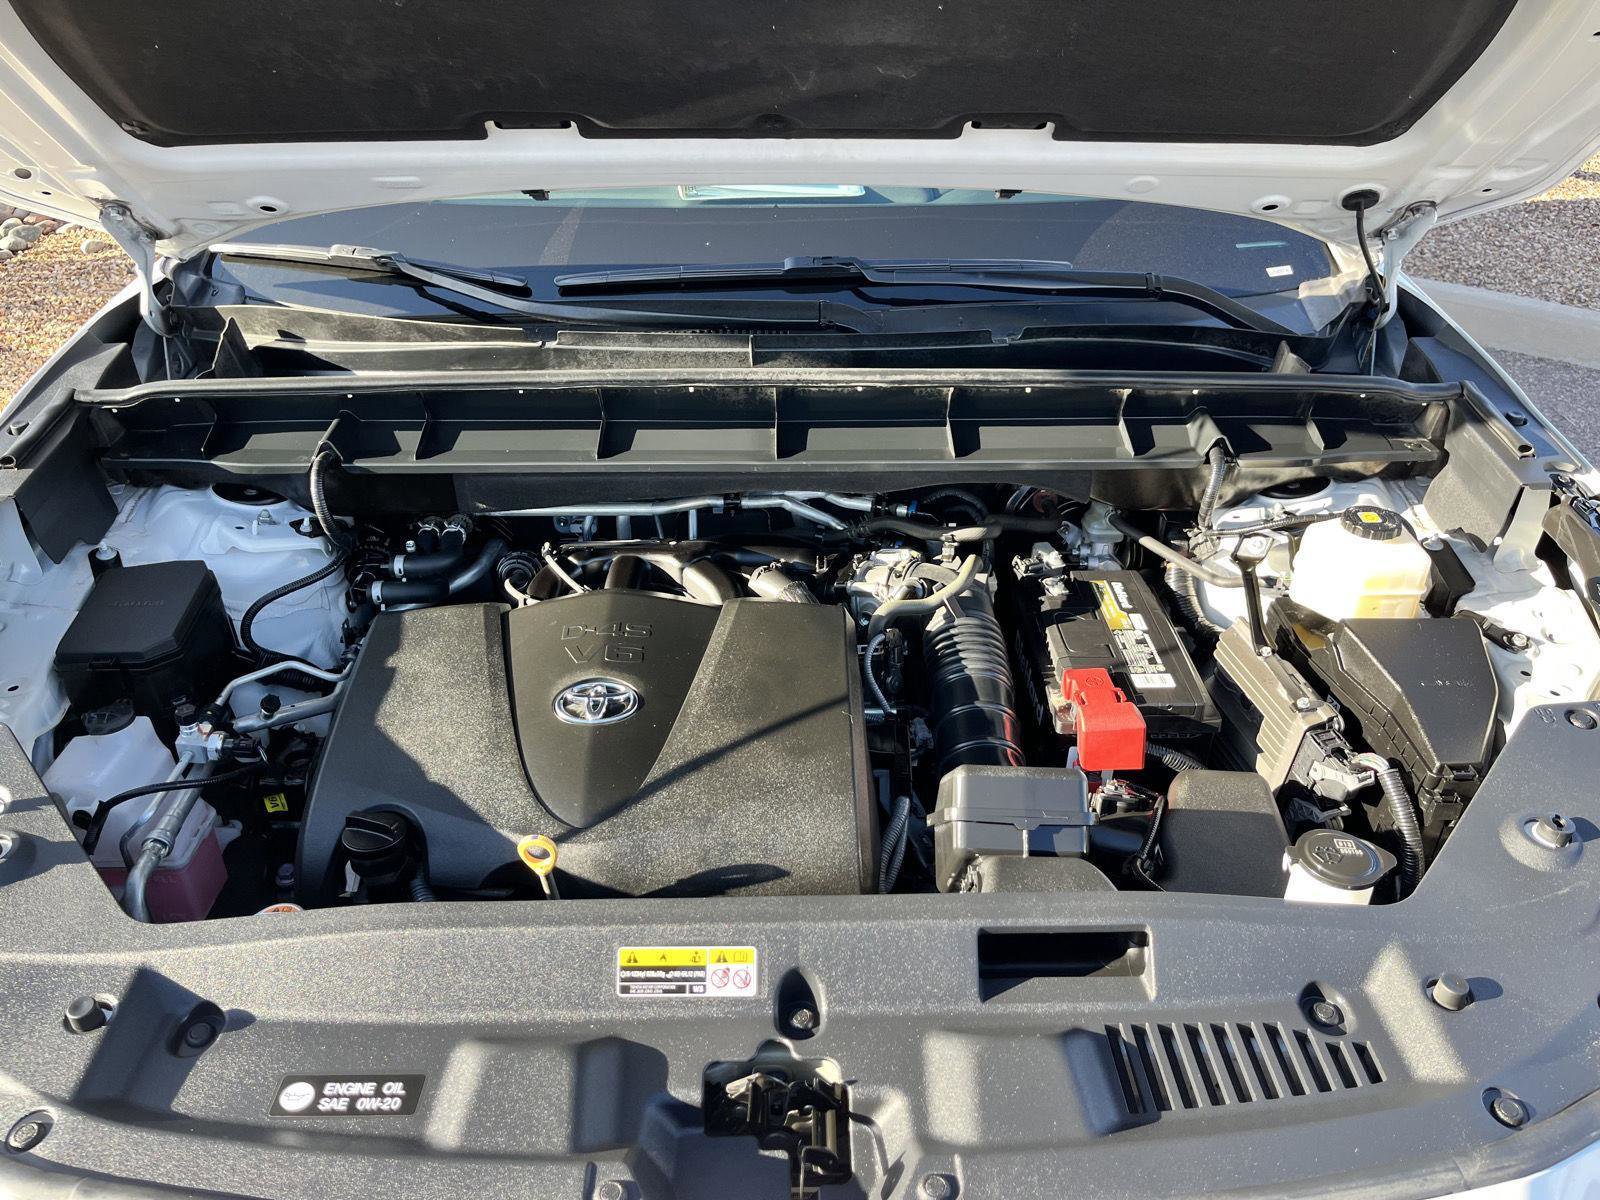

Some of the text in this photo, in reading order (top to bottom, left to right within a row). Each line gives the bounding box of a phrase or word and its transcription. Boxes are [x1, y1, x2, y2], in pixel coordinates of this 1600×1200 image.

[563, 642, 645, 663] V6
[322, 1081, 406, 1096] ENGINE OIL
[317, 1097, 402, 1111] SAE 0W-20
